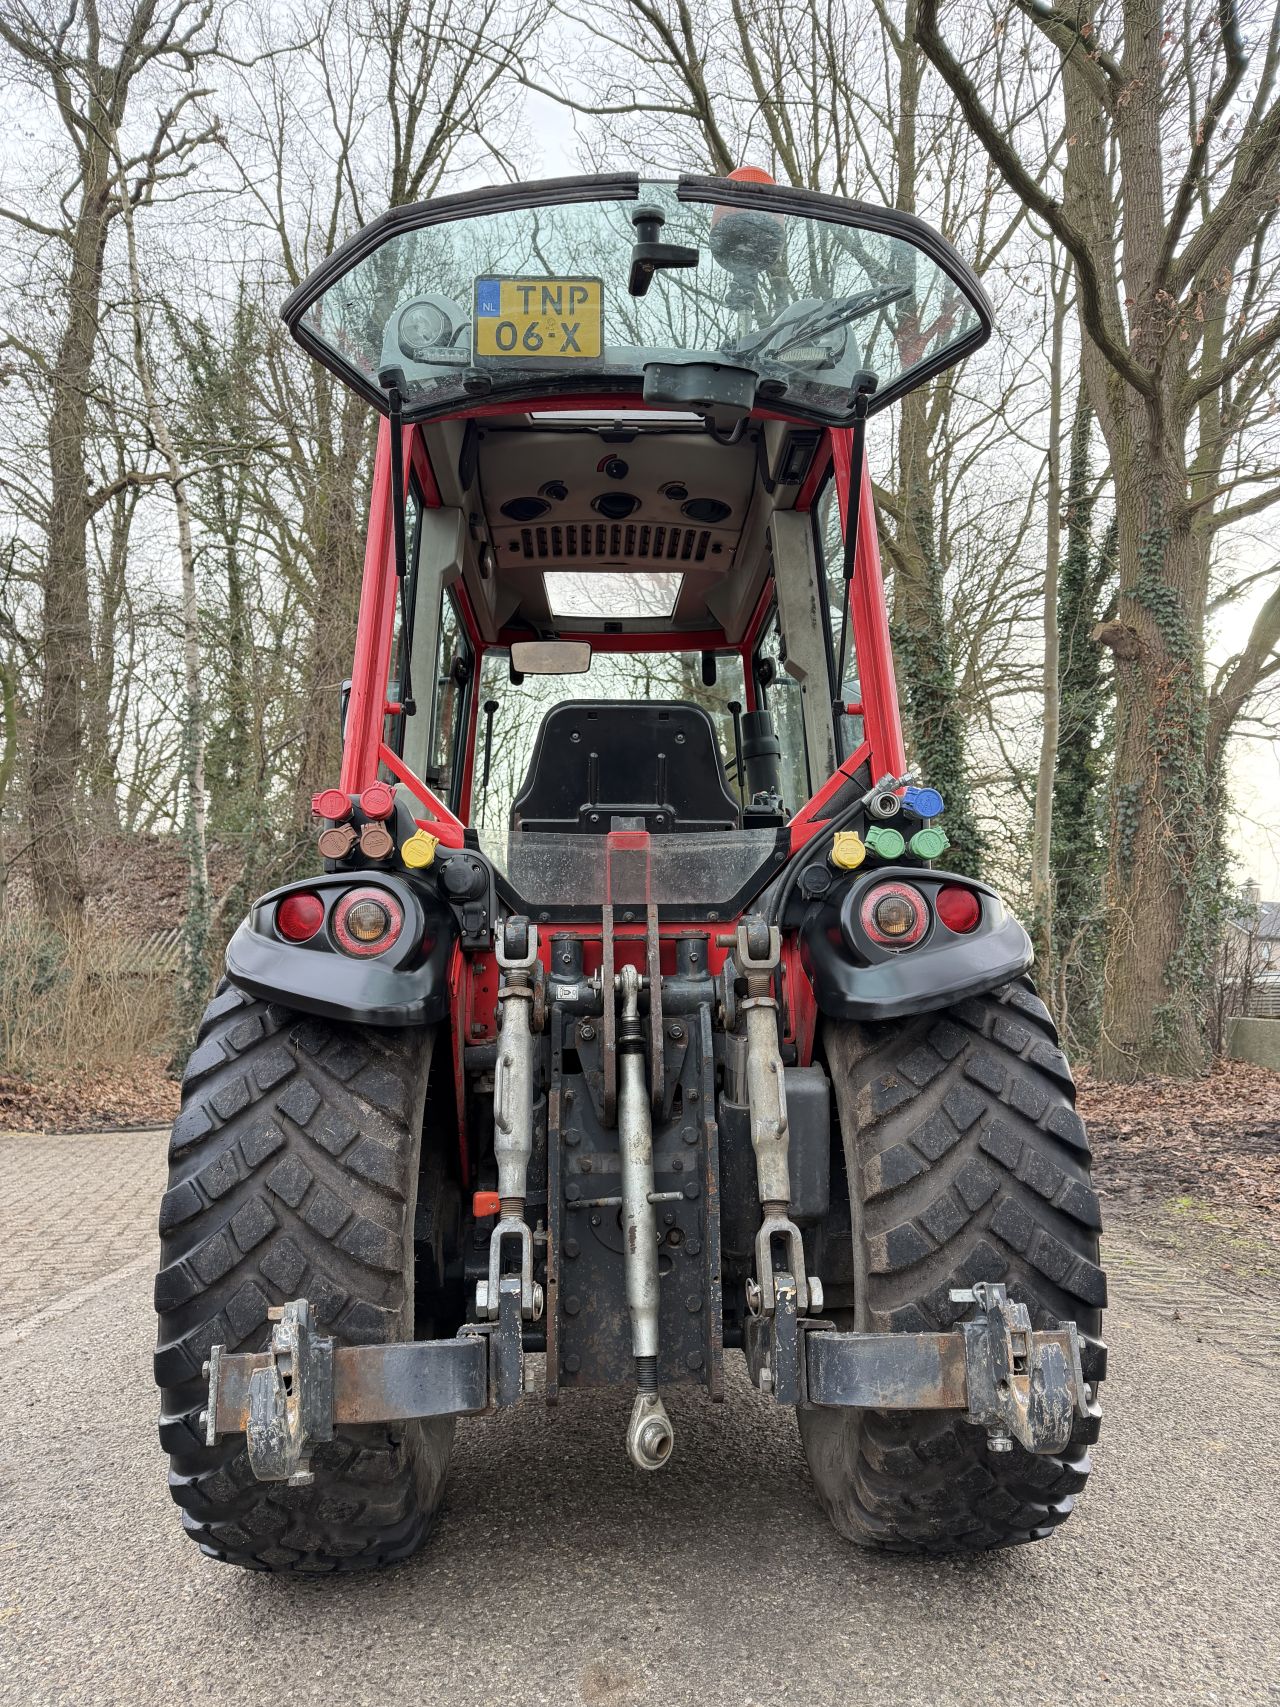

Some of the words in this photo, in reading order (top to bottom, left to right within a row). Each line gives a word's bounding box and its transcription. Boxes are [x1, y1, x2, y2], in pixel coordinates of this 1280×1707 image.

[482, 302, 496, 312] NL
[516, 285, 589, 316] TNP
[495, 320, 582, 353] 06-X
